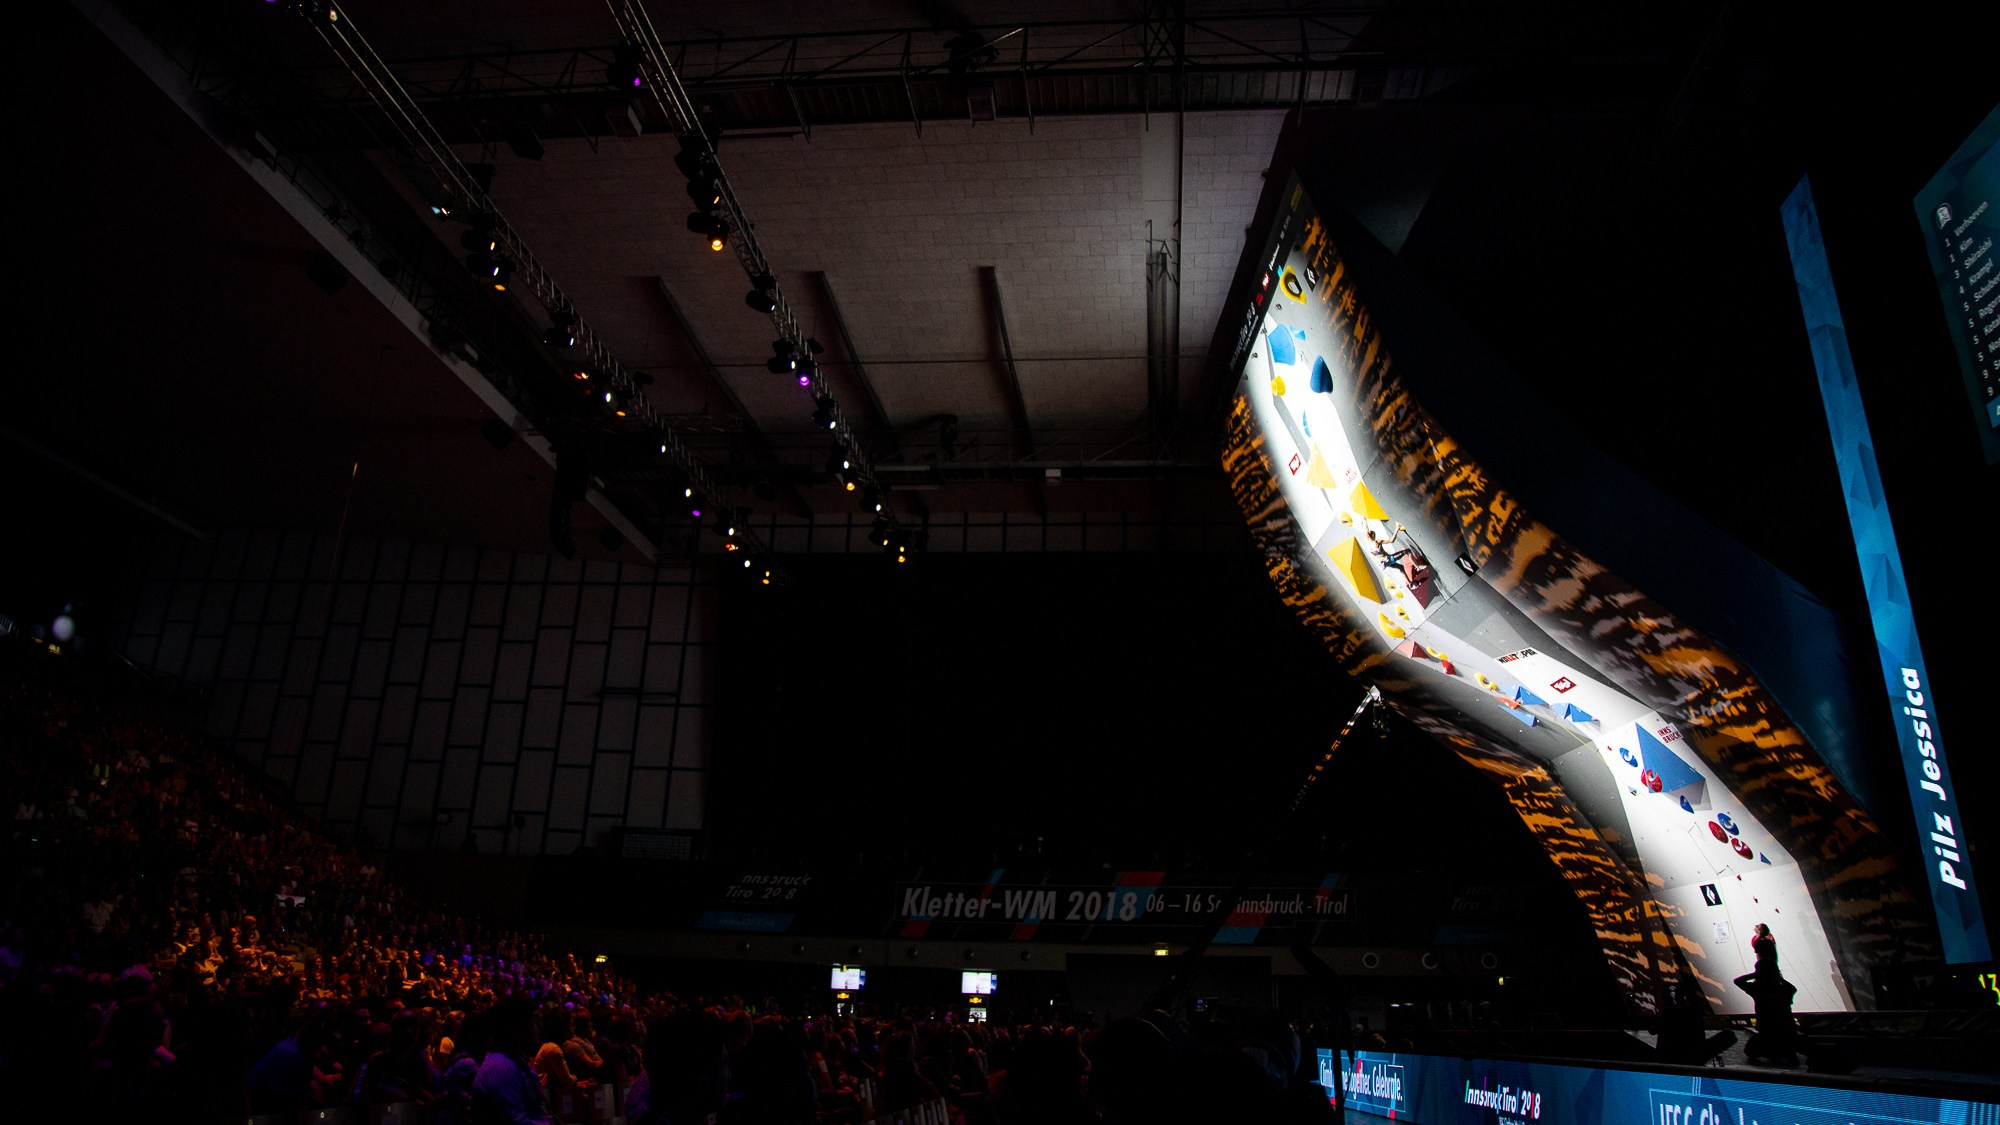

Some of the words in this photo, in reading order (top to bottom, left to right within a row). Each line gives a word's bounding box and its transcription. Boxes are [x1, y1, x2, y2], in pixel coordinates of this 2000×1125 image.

[1960, 237, 1974, 254] Kim
[1954, 269, 1960, 280] 3
[1963, 301, 1970, 312] 5
[1968, 318, 1975, 329] 5
[1973, 334, 1980, 345] 5
[1978, 351, 1985, 362] 5
[1982, 369, 1989, 379] 9
[1987, 386, 1994, 397] 9
[1900, 667, 1946, 801] Jessica
[1930, 811, 1967, 891] Pilz
[901, 886, 1057, 922] Kletter-WM
[1068, 890, 1138, 924] 2018
[1146, 894, 1165, 914] 06
[1184, 894, 1202, 914] 16
[1315, 894, 1349, 915] Tirol
[1373, 1063, 1403, 1101] Celebrate.
[1520, 1090, 1541, 1120] 2018
